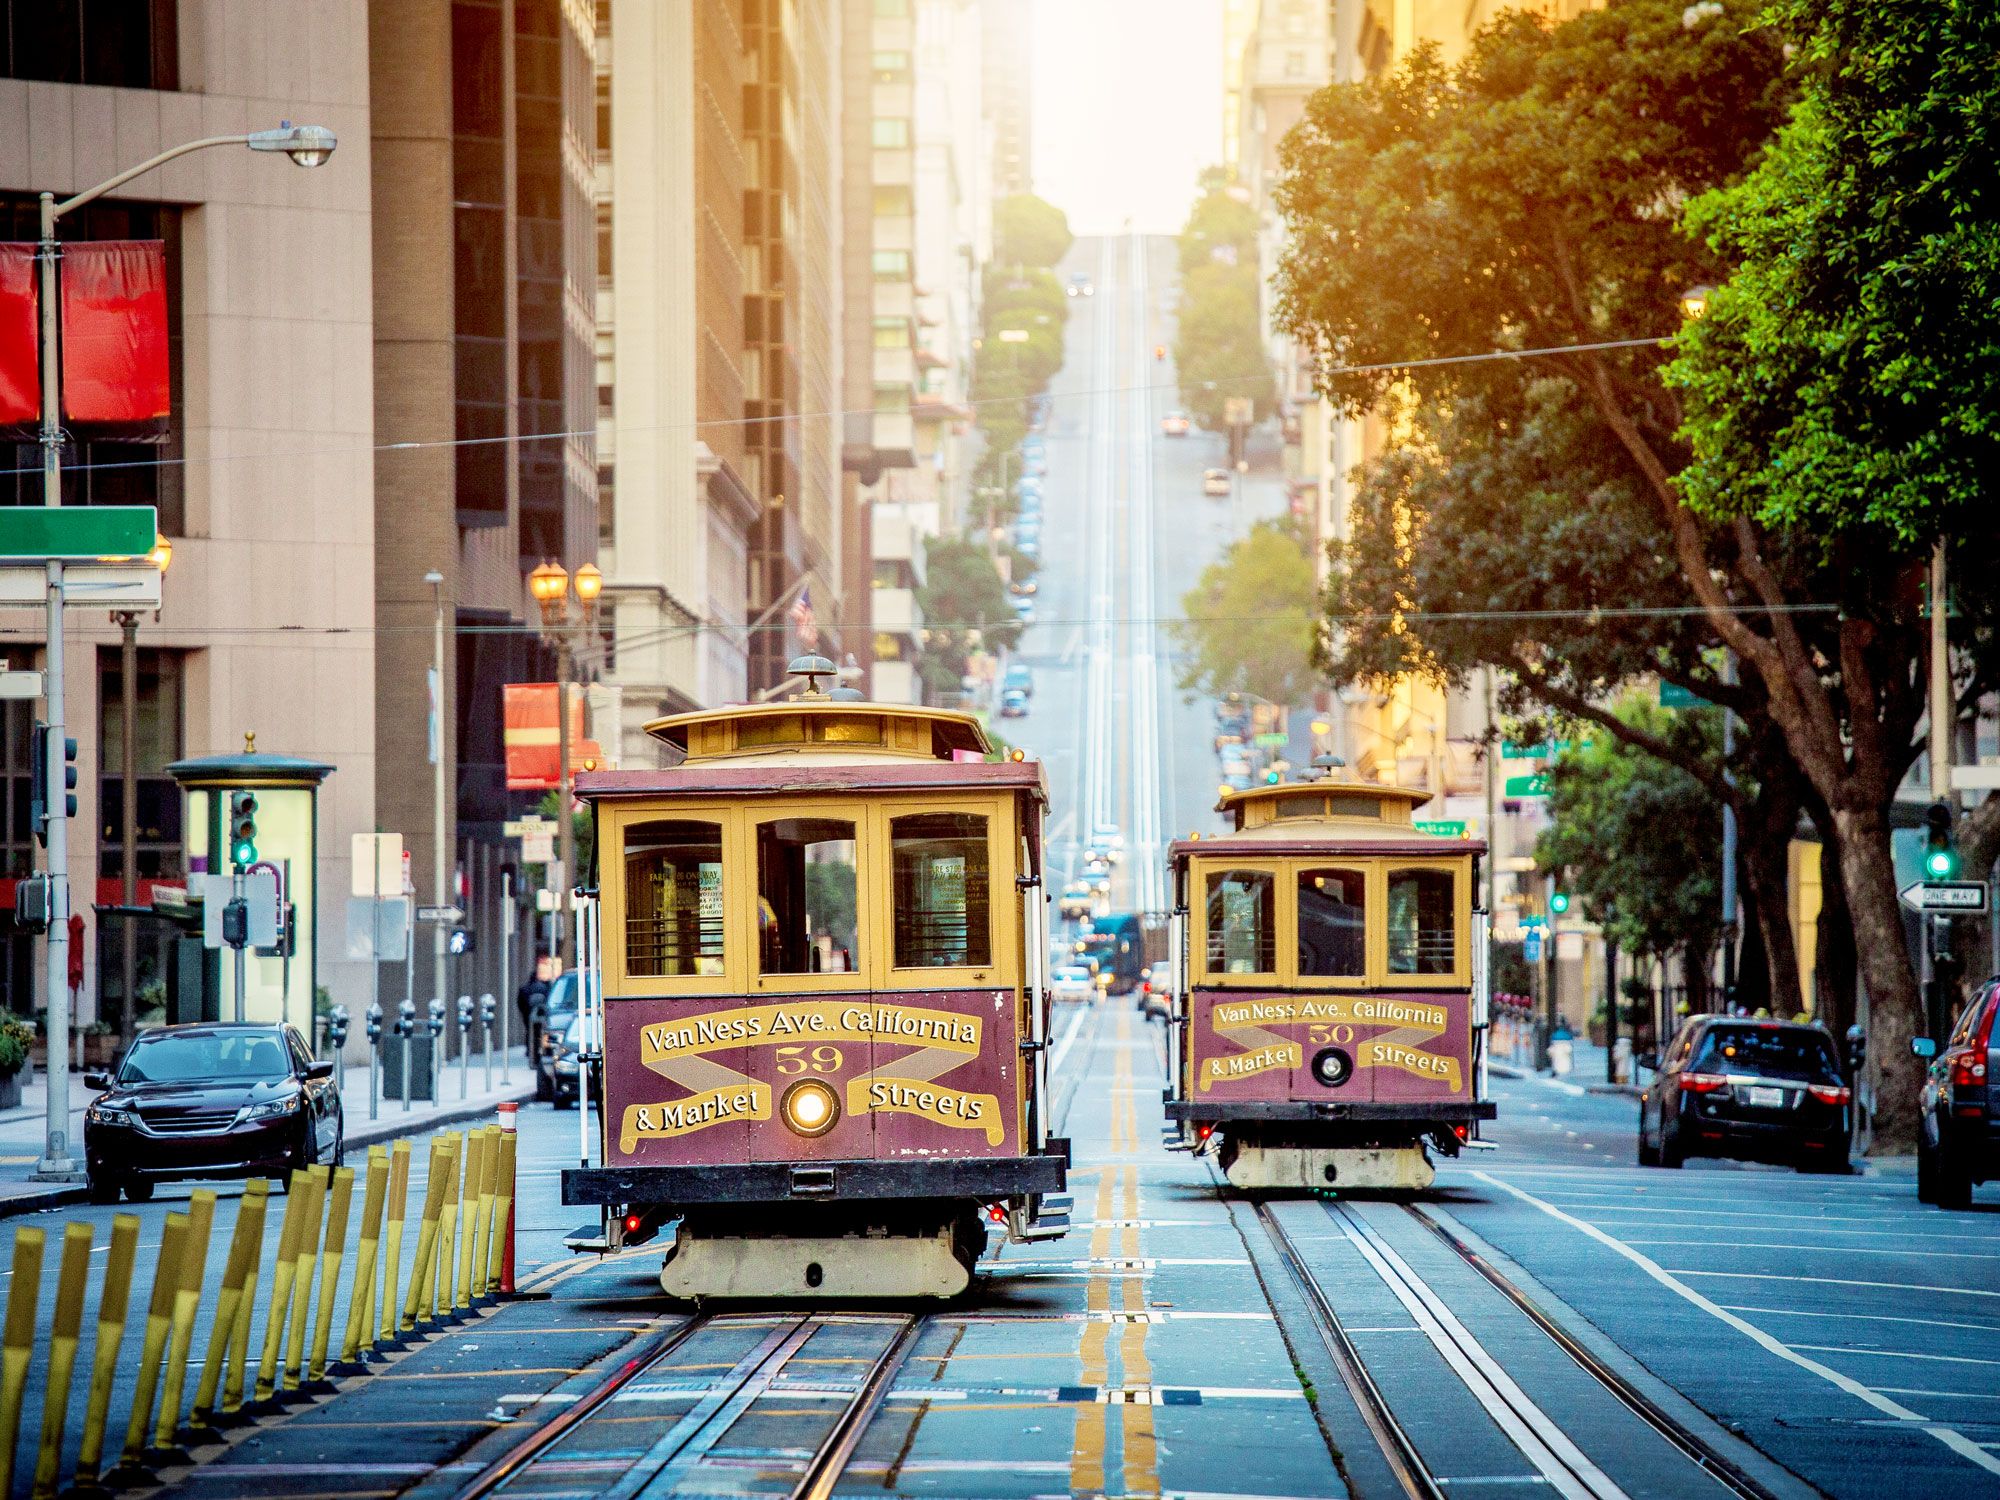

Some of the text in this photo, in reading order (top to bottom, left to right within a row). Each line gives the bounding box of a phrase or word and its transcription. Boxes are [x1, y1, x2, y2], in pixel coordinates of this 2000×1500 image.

[1924, 889, 1976, 901] ONE WAY
[1218, 1006, 1249, 1024] Van
[1251, 1003, 1296, 1020] Ness
[1352, 1001, 1443, 1025] California
[647, 1026, 695, 1053] Van
[695, 1015, 763, 1045] Ness
[840, 1007, 976, 1044] California
[1308, 1024, 1354, 1044] 50
[775, 1045, 844, 1075] 59
[1210, 1045, 1450, 1076] & Market Streets
[636, 1081, 985, 1131] & Market Streets
